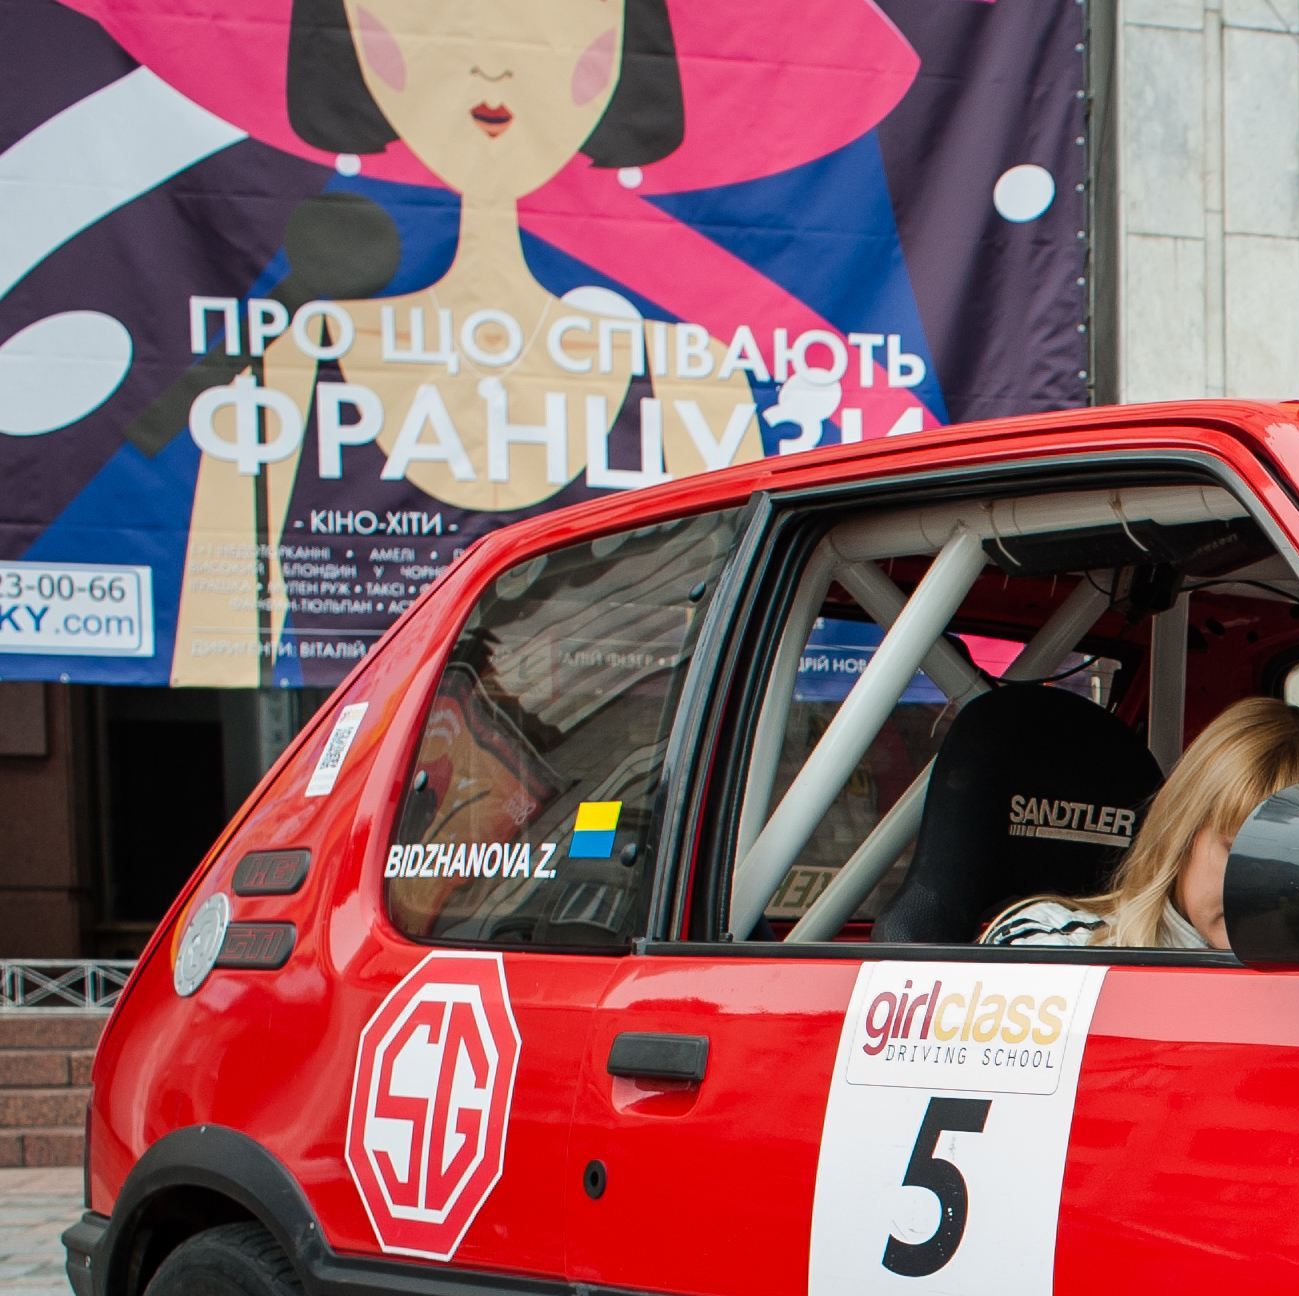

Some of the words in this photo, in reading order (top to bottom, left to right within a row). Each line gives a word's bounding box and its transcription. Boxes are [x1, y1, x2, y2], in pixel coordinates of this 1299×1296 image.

[190, 296, 355, 361] ПРО
[382, 306, 522, 372] ЩО
[546, 316, 926, 389] СПІВАЮТЬ
[311, 510, 442, 535] КІНО-ХІТИ
[0, 573, 126, 602] 3-00-66
[1009, 794, 1136, 837] SANDTLER
[384, 843, 532, 878] BIDZHANOVA
[533, 842, 557, 879] Z.
[885, 1044, 967, 1065] DRIVING
[981, 1048, 1055, 1069] SCHOOL
[881, 1097, 993, 1278] 5
